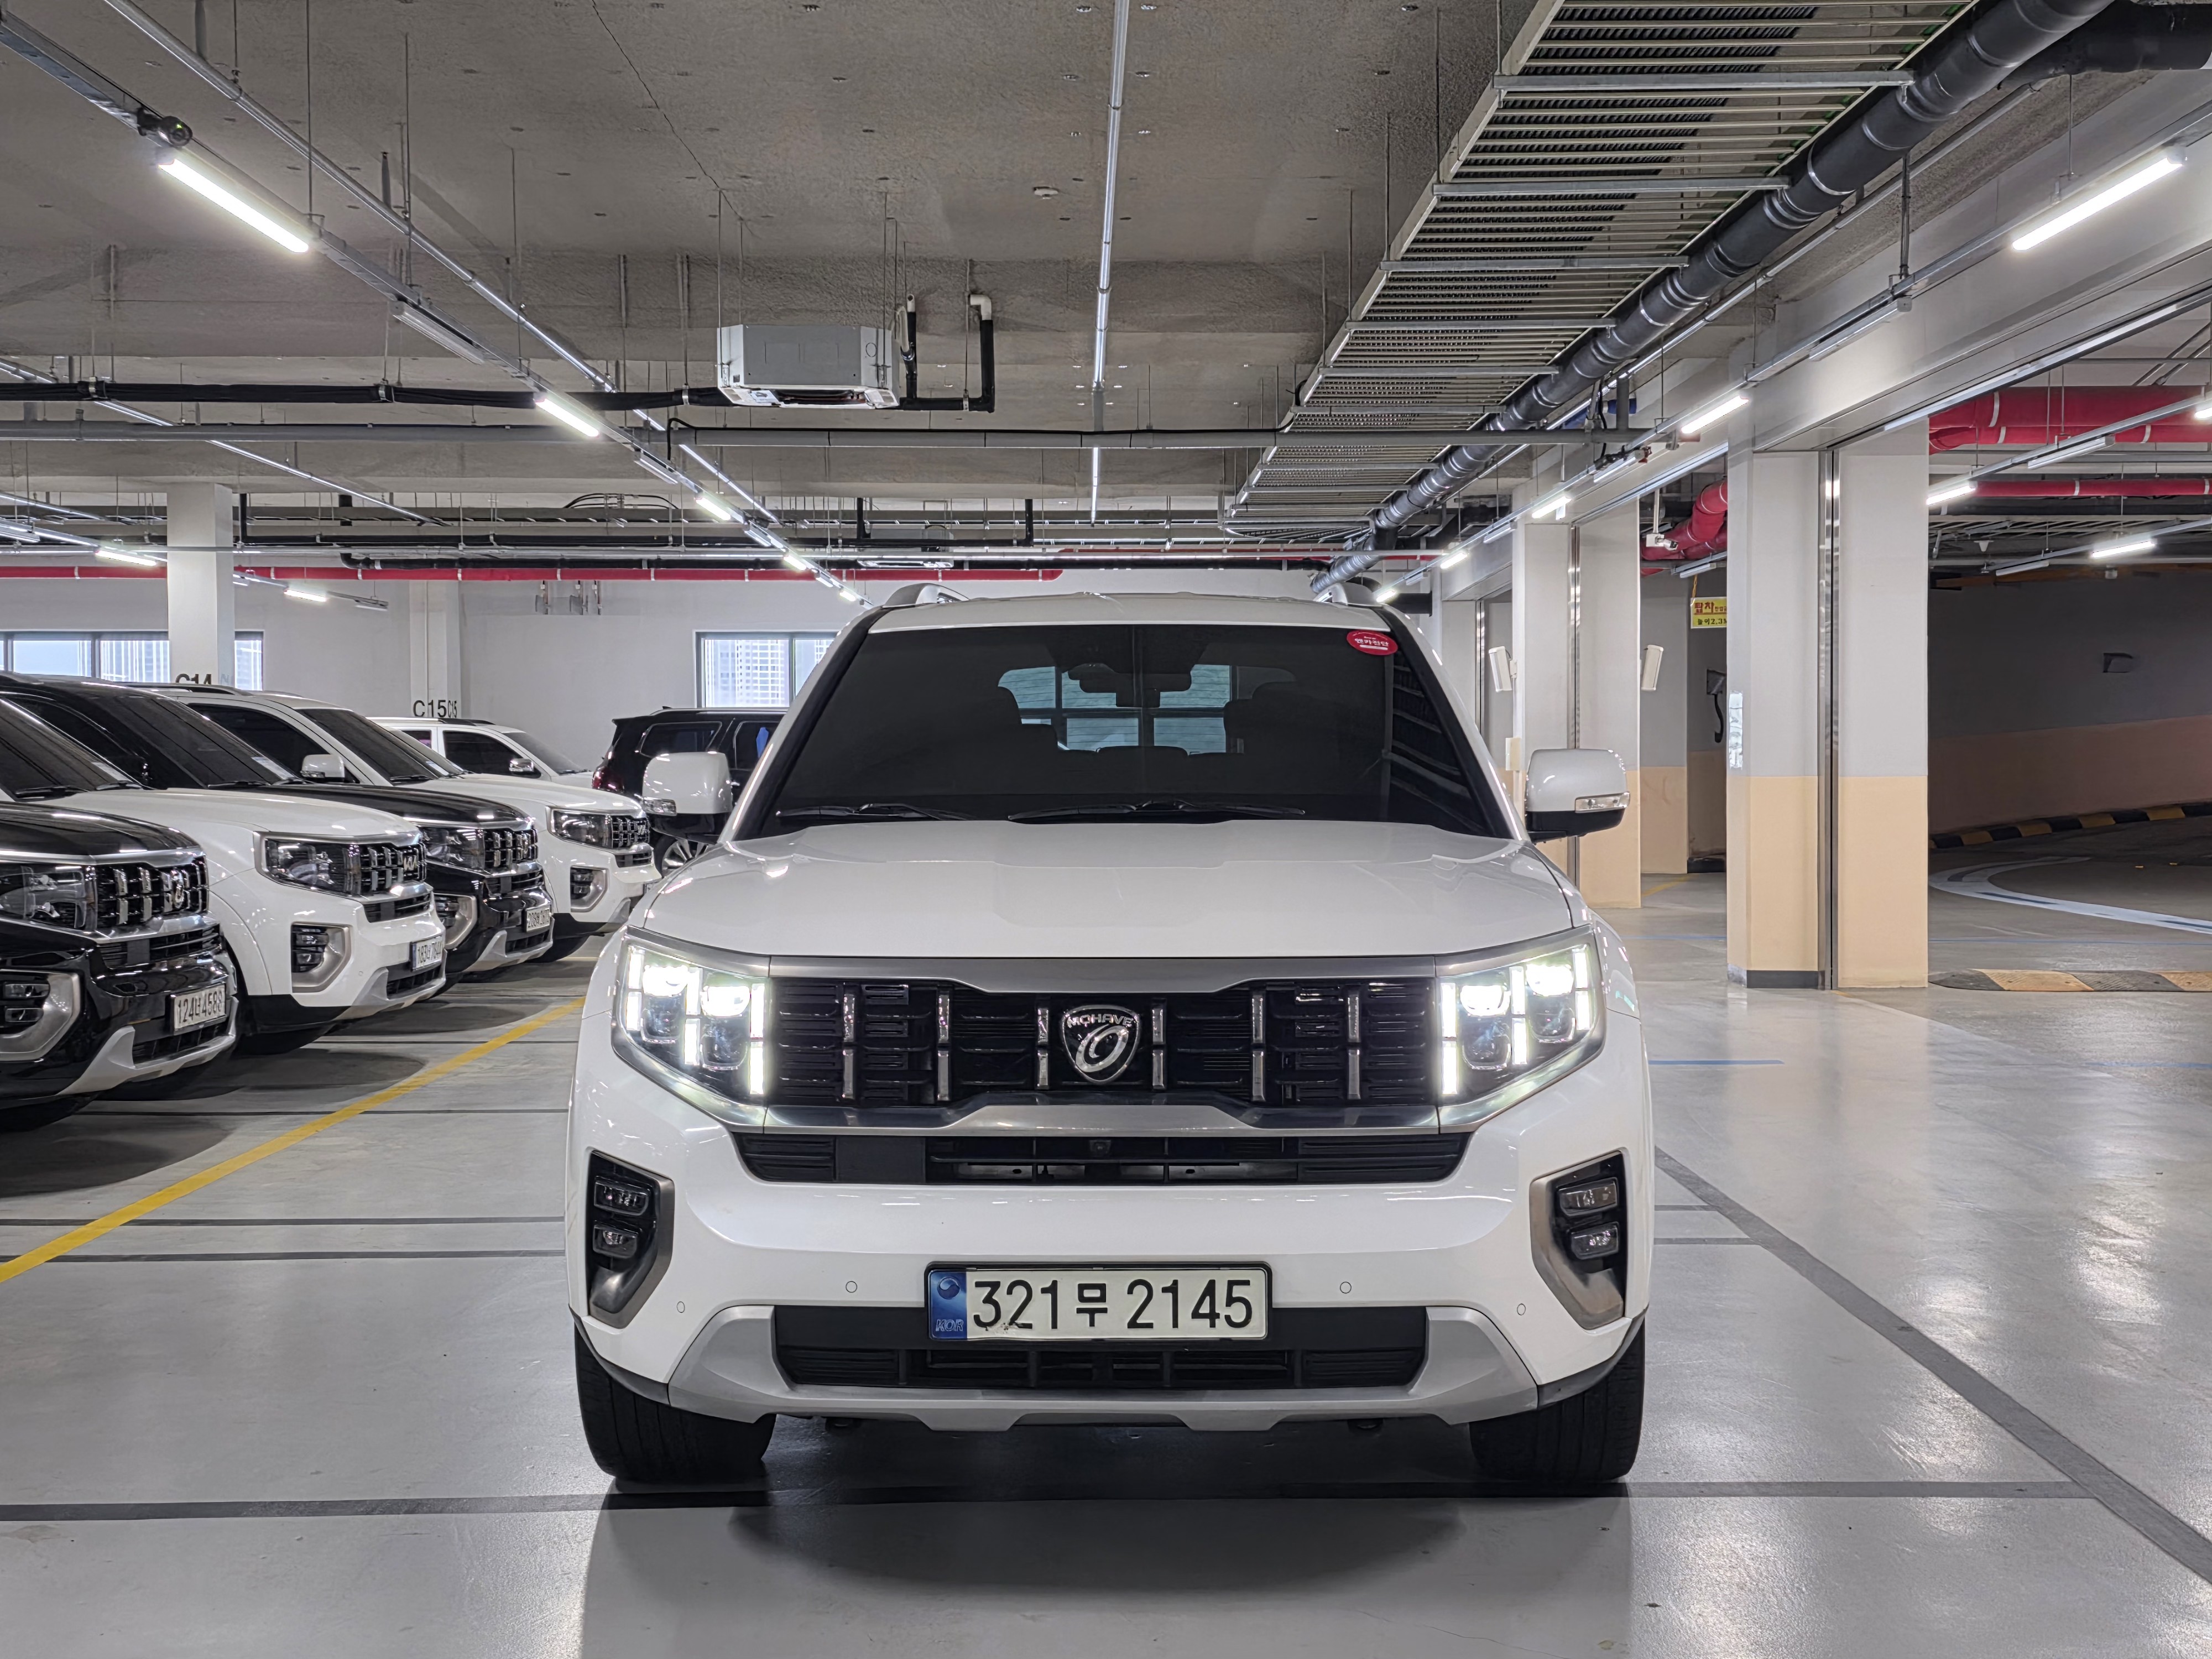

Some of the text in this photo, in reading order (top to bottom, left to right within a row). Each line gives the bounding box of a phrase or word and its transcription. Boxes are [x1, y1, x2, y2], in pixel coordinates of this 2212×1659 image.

[413, 700, 447, 718] C15
[1067, 1013, 1134, 1028] MOHAVE
[973, 1279, 1253, 1329] 321무 2145
[935, 1319, 963, 1332] KOR
